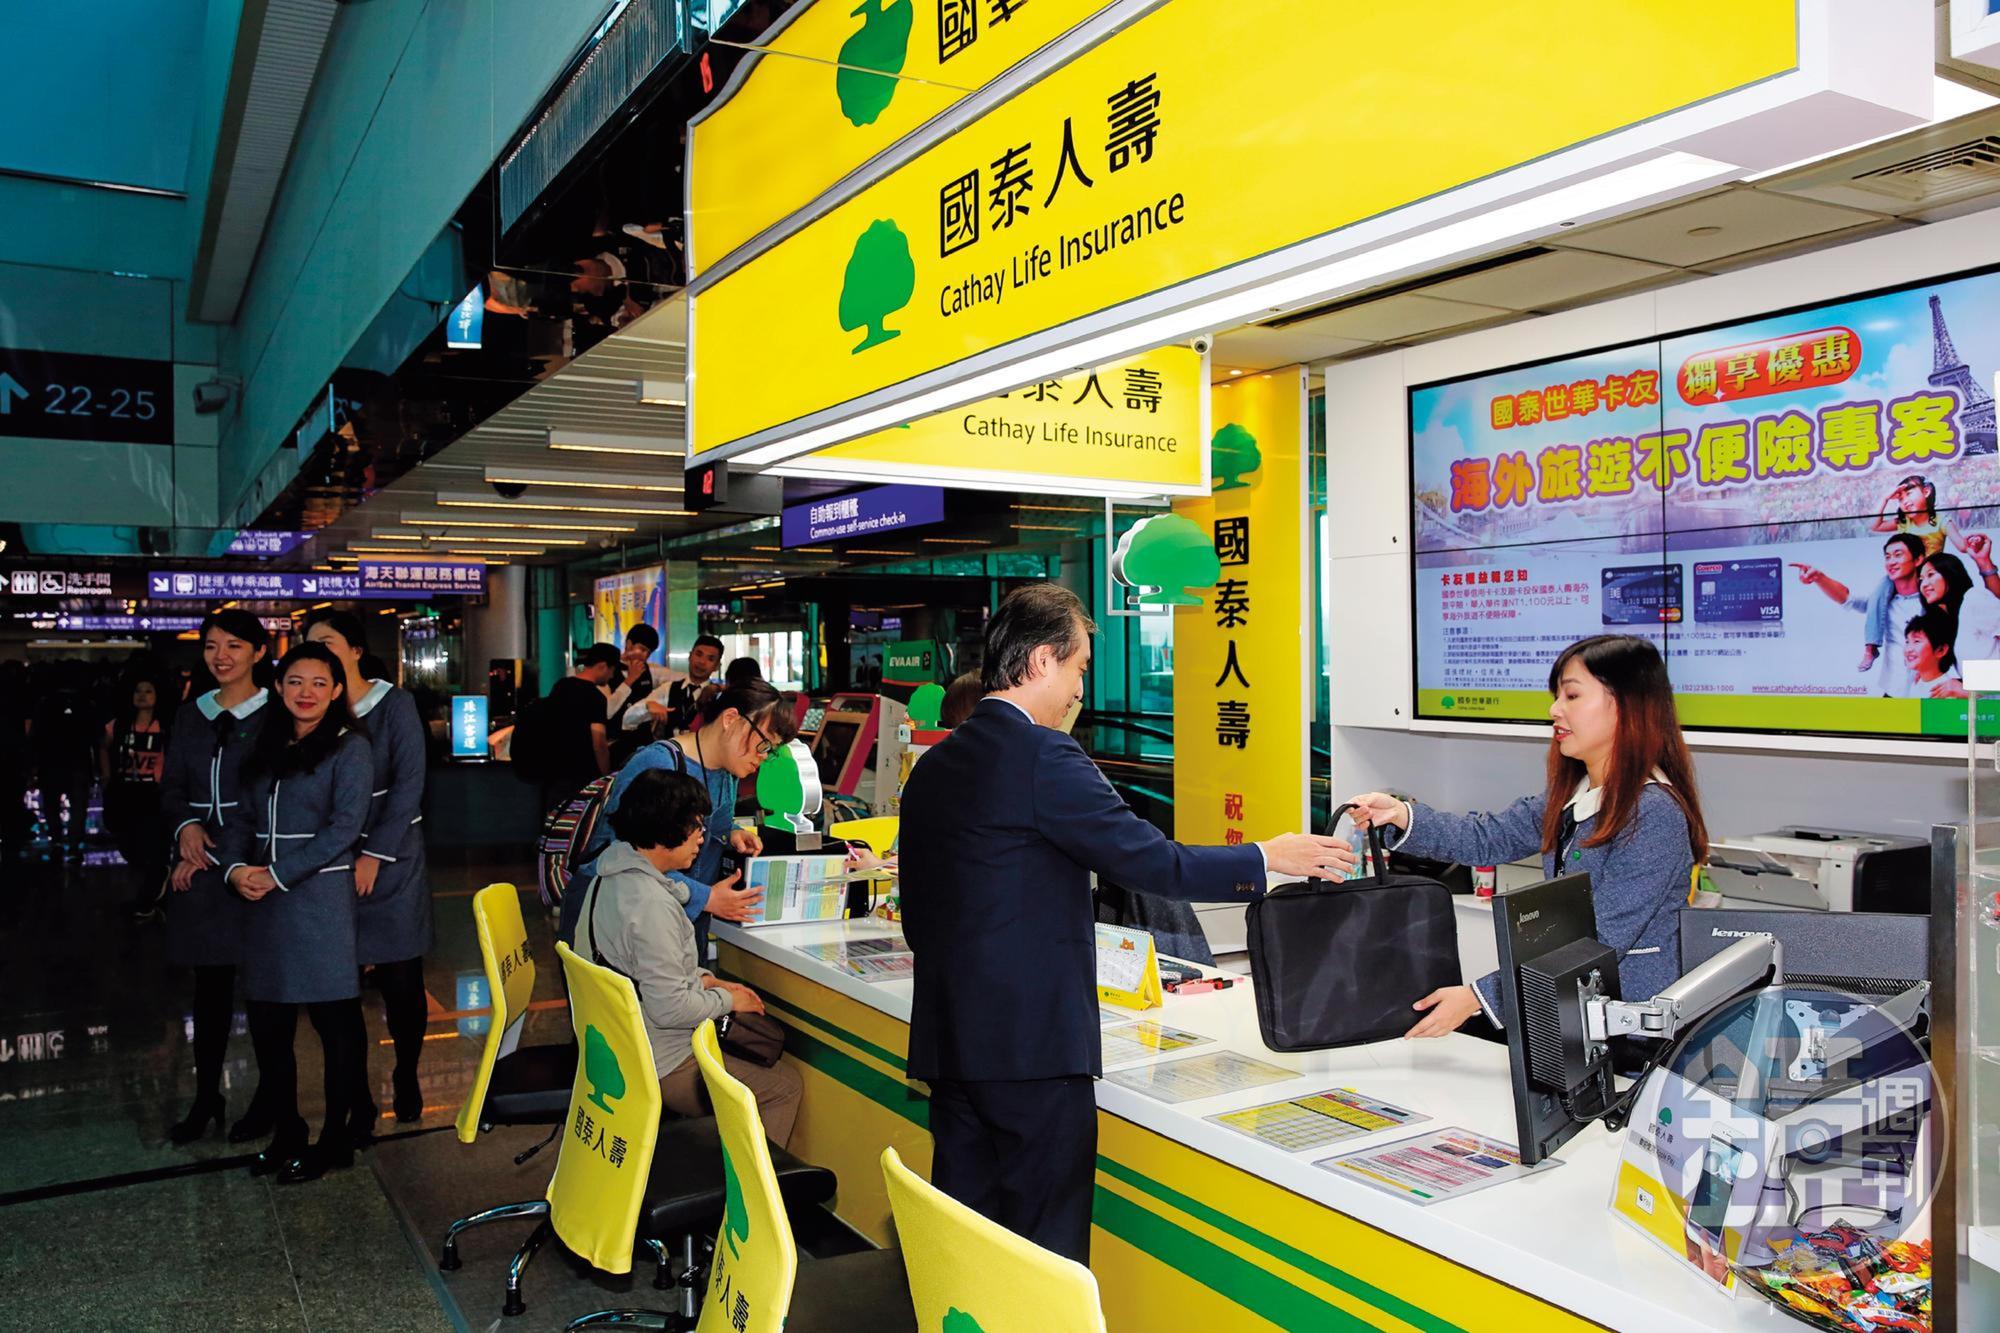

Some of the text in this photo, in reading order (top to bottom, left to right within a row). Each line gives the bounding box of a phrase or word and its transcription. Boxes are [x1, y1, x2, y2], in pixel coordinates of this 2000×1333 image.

[939, 72, 1162, 259] 國泰人壽
[940, 191, 1185, 318] Cathay Life Insurance
[997, 368, 1162, 414] 泰人壽
[1685, 333, 1852, 398] 獨享優惠
[44, 384, 155, 419] 22-25
[1492, 371, 1658, 429] 國泰世華卡友
[963, 414, 1177, 452] Cathay Life Insurance
[1451, 390, 1959, 512] 海外旅遊不便險專案
[880, 512, 906, 527] check-in
[67, 587, 112, 595] Restroom
[1759, 606, 1780, 615] VISA
[1214, 515, 1250, 750] 國泰人壽
[1711, 927, 1773, 939] lenovo
[575, 1105, 627, 1169] 國泰人壽
